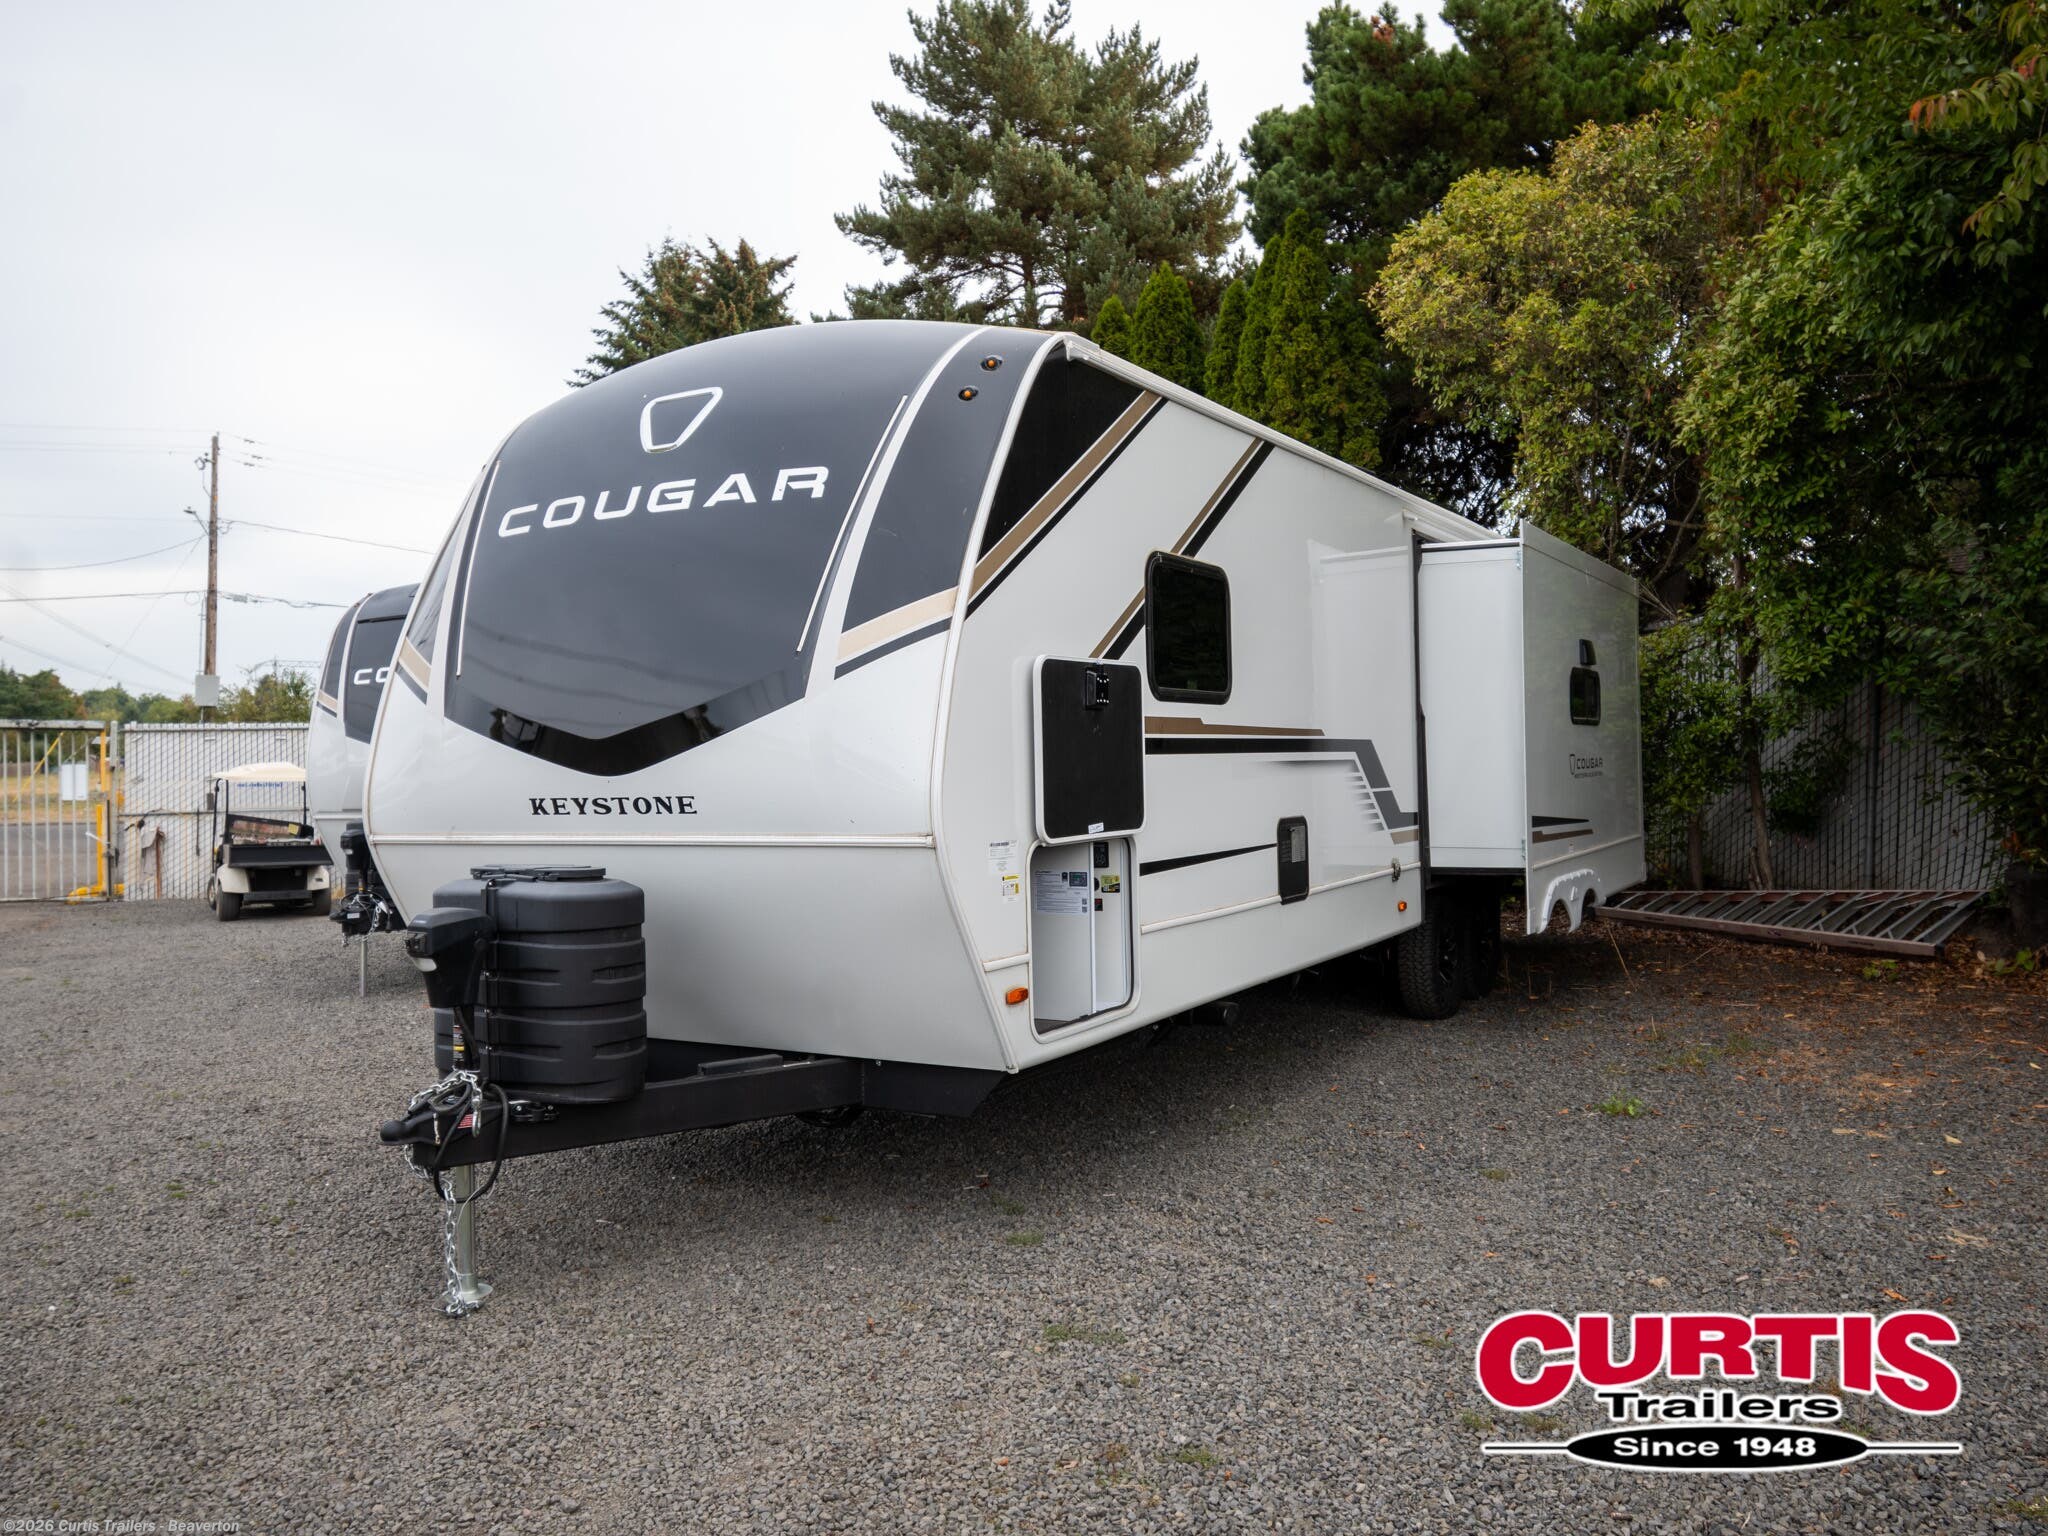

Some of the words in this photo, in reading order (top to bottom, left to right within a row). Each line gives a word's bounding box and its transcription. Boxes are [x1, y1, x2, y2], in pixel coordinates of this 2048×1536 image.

[498, 466, 829, 537] COUGAR
[1577, 757, 1603, 769] COUGAR
[528, 795, 698, 816] KEYSTONE
